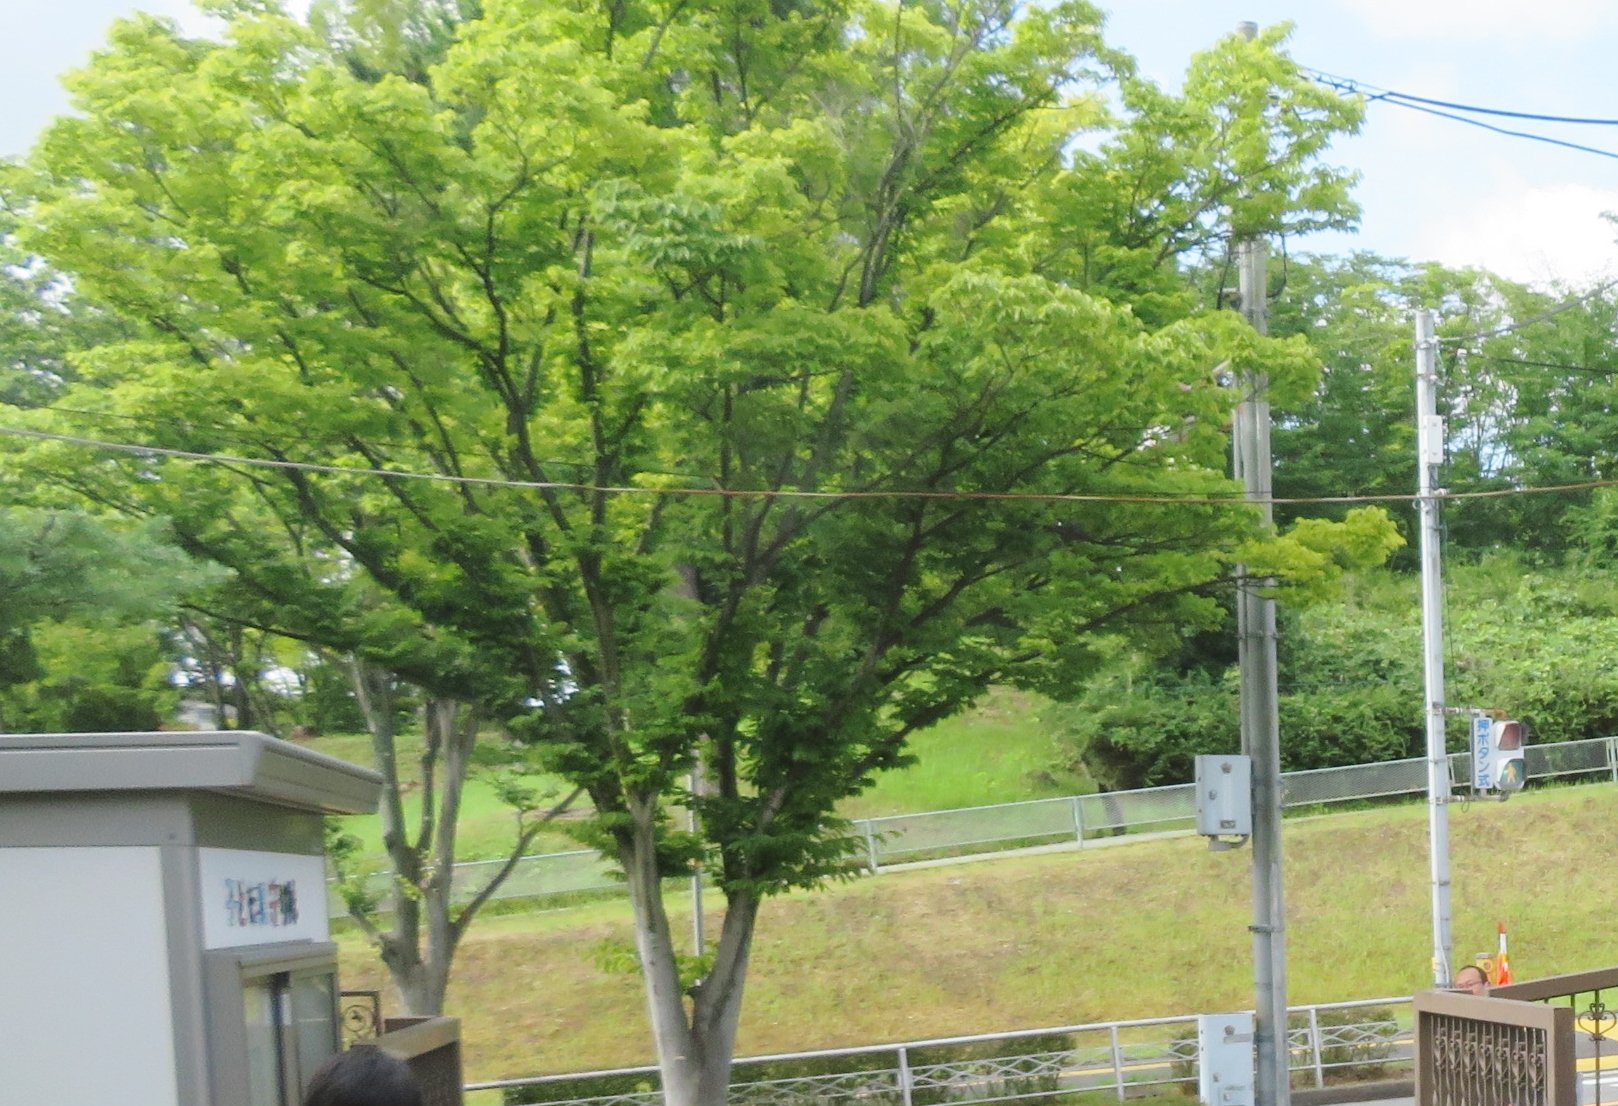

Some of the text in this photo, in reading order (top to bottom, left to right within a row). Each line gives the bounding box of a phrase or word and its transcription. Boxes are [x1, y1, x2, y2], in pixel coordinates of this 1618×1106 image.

[1478, 719, 1490, 786] 押ボタン式
